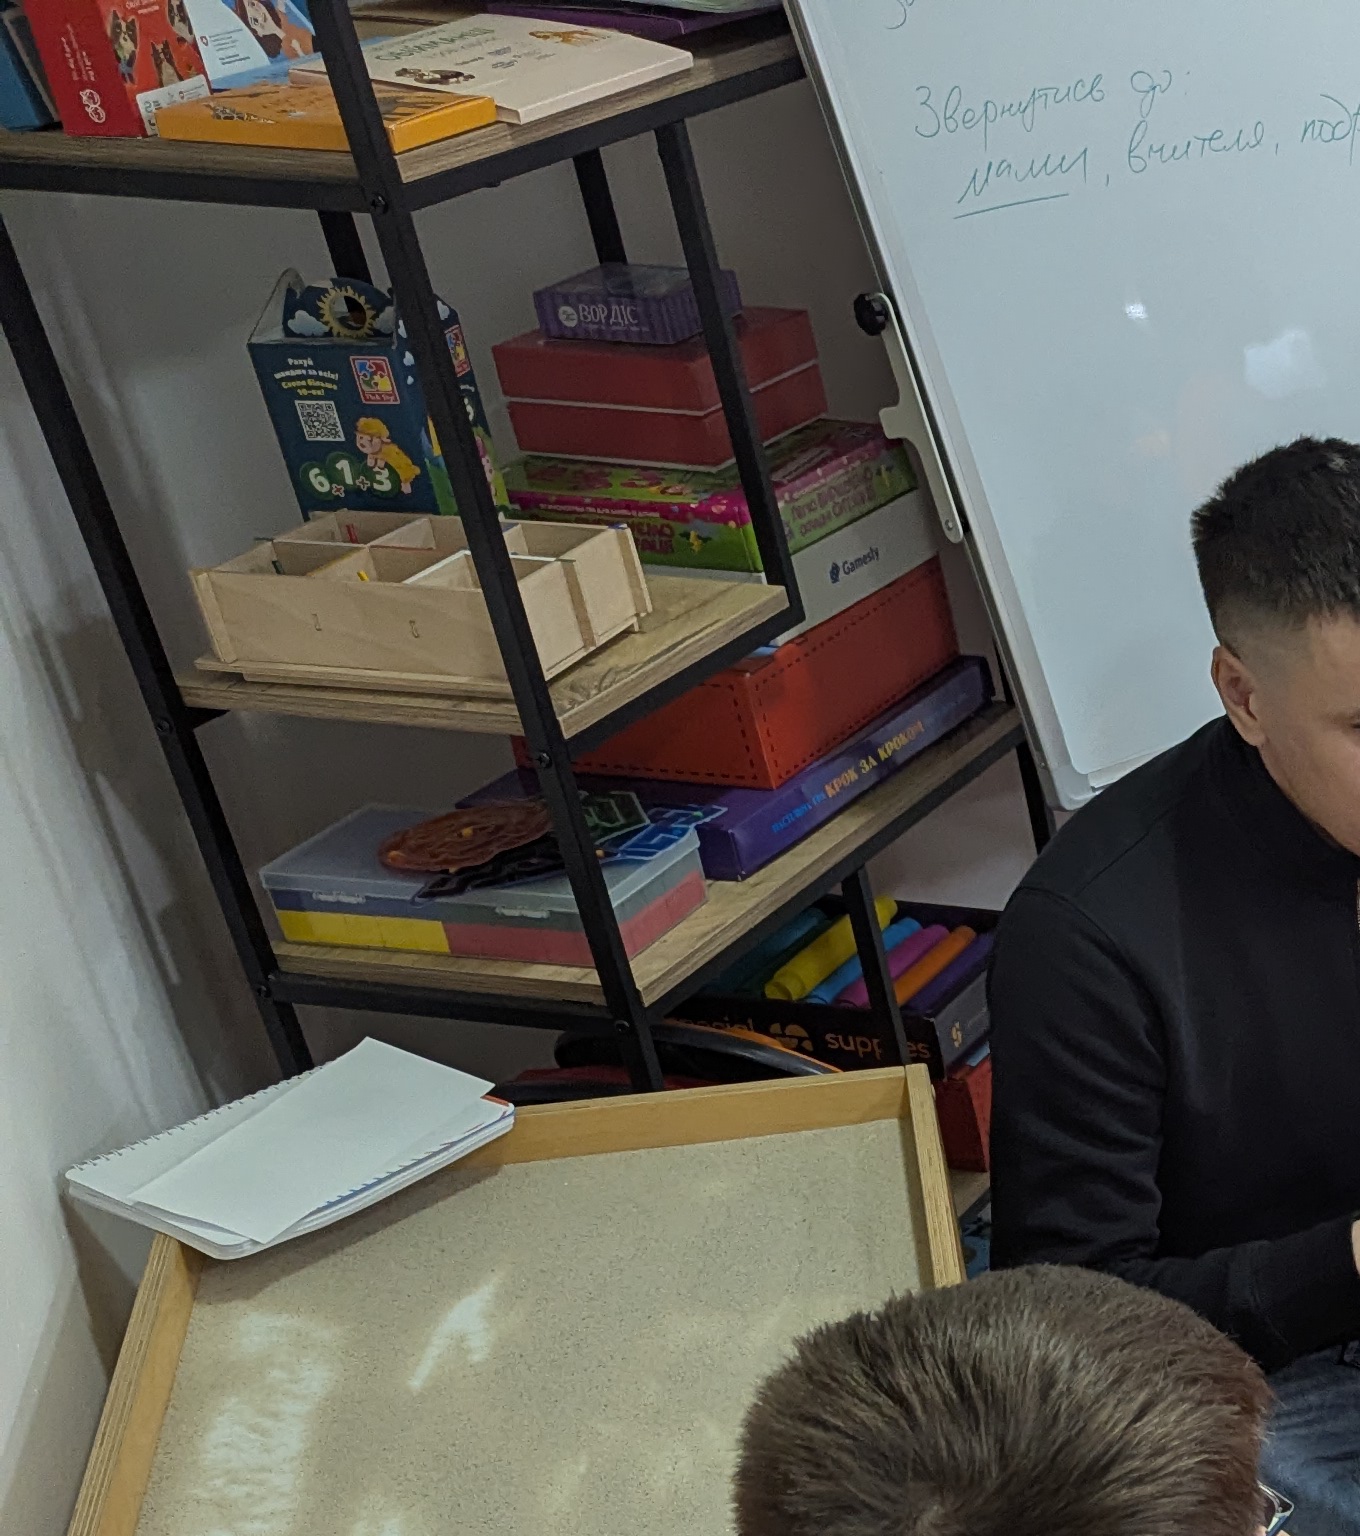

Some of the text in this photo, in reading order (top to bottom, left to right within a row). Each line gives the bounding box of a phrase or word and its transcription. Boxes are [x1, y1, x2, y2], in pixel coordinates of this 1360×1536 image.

[308, 468, 331, 493] 6
[335, 459, 355, 486] 1
[373, 466, 393, 492] 3
[842, 546, 879, 576] Gamesly
[824, 766, 859, 798] КРОК
[859, 755, 878, 774] ЗА
